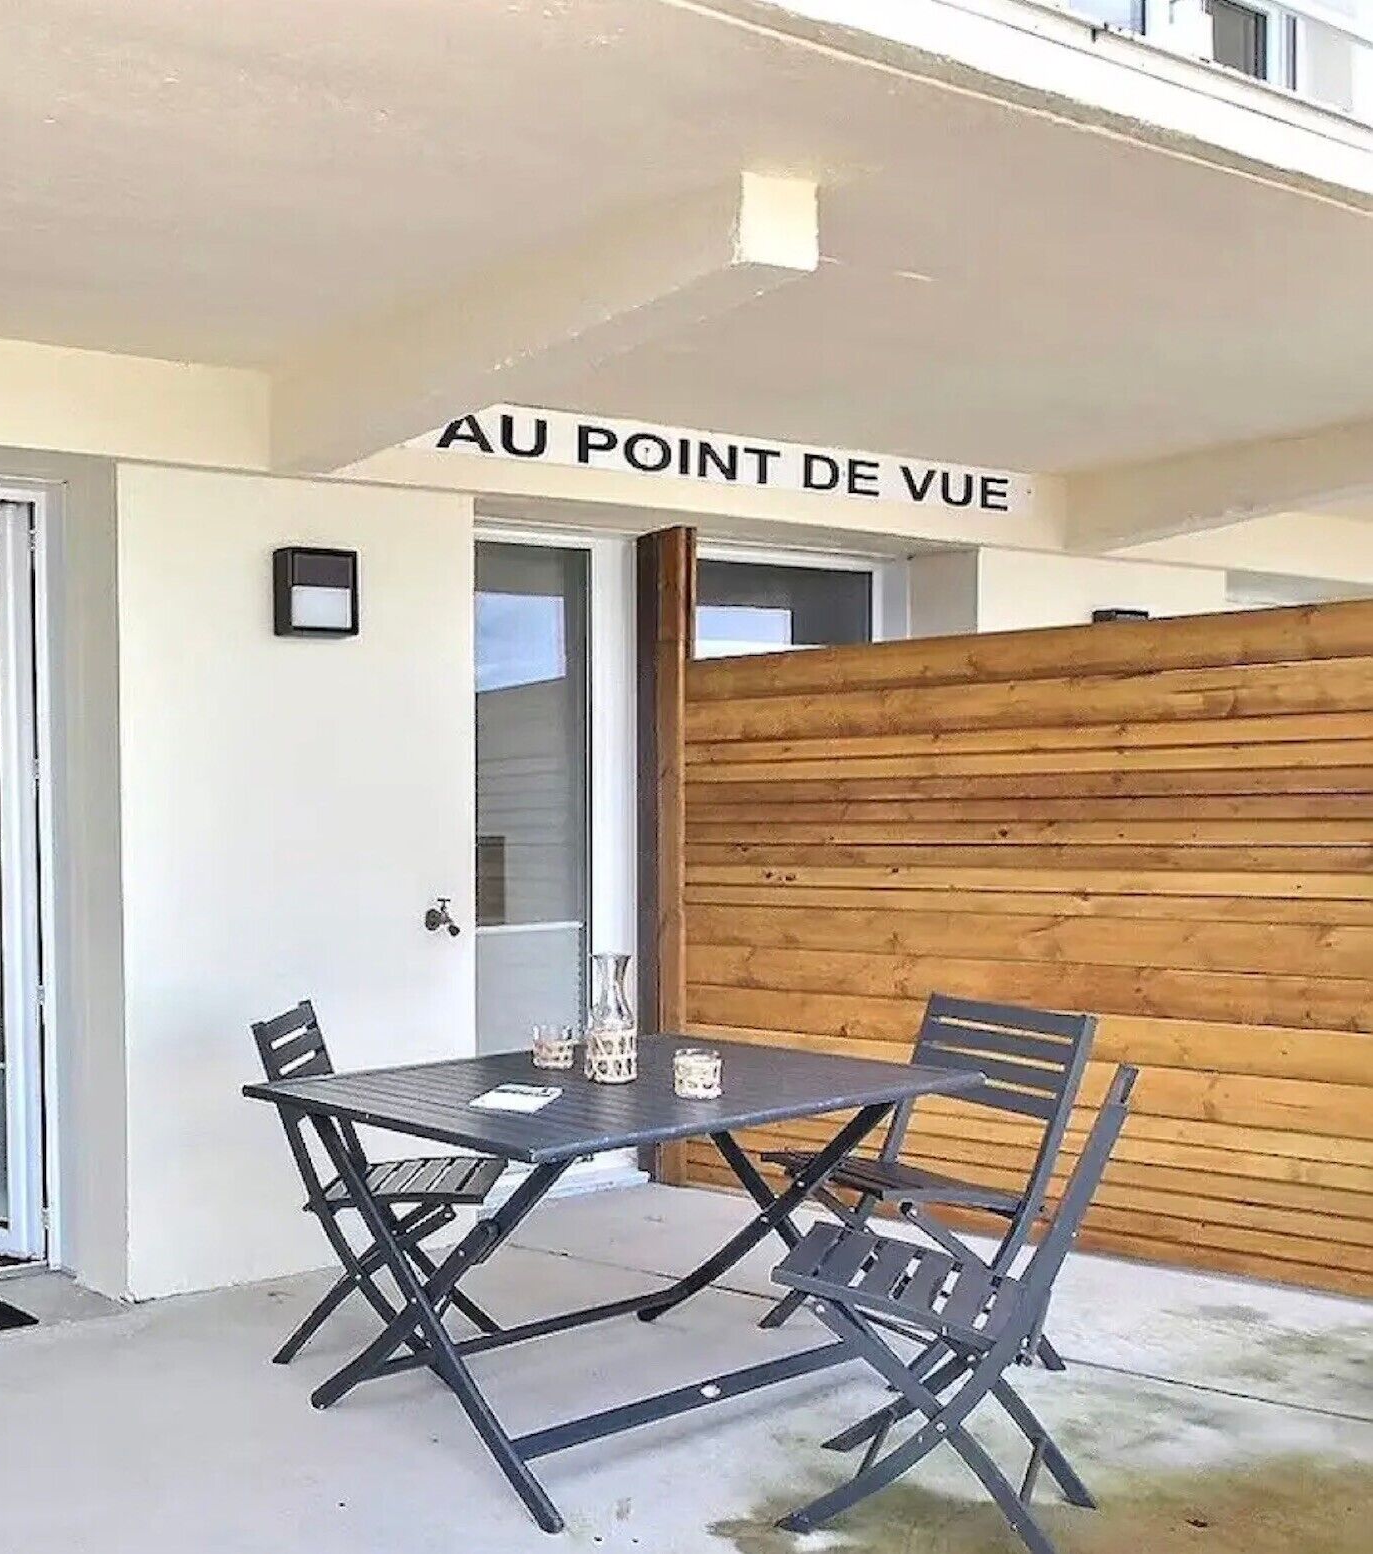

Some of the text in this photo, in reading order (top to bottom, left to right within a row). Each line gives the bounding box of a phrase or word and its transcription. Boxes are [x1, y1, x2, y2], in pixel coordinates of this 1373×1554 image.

[435, 414, 1009, 512] AU POINT DE VUE
